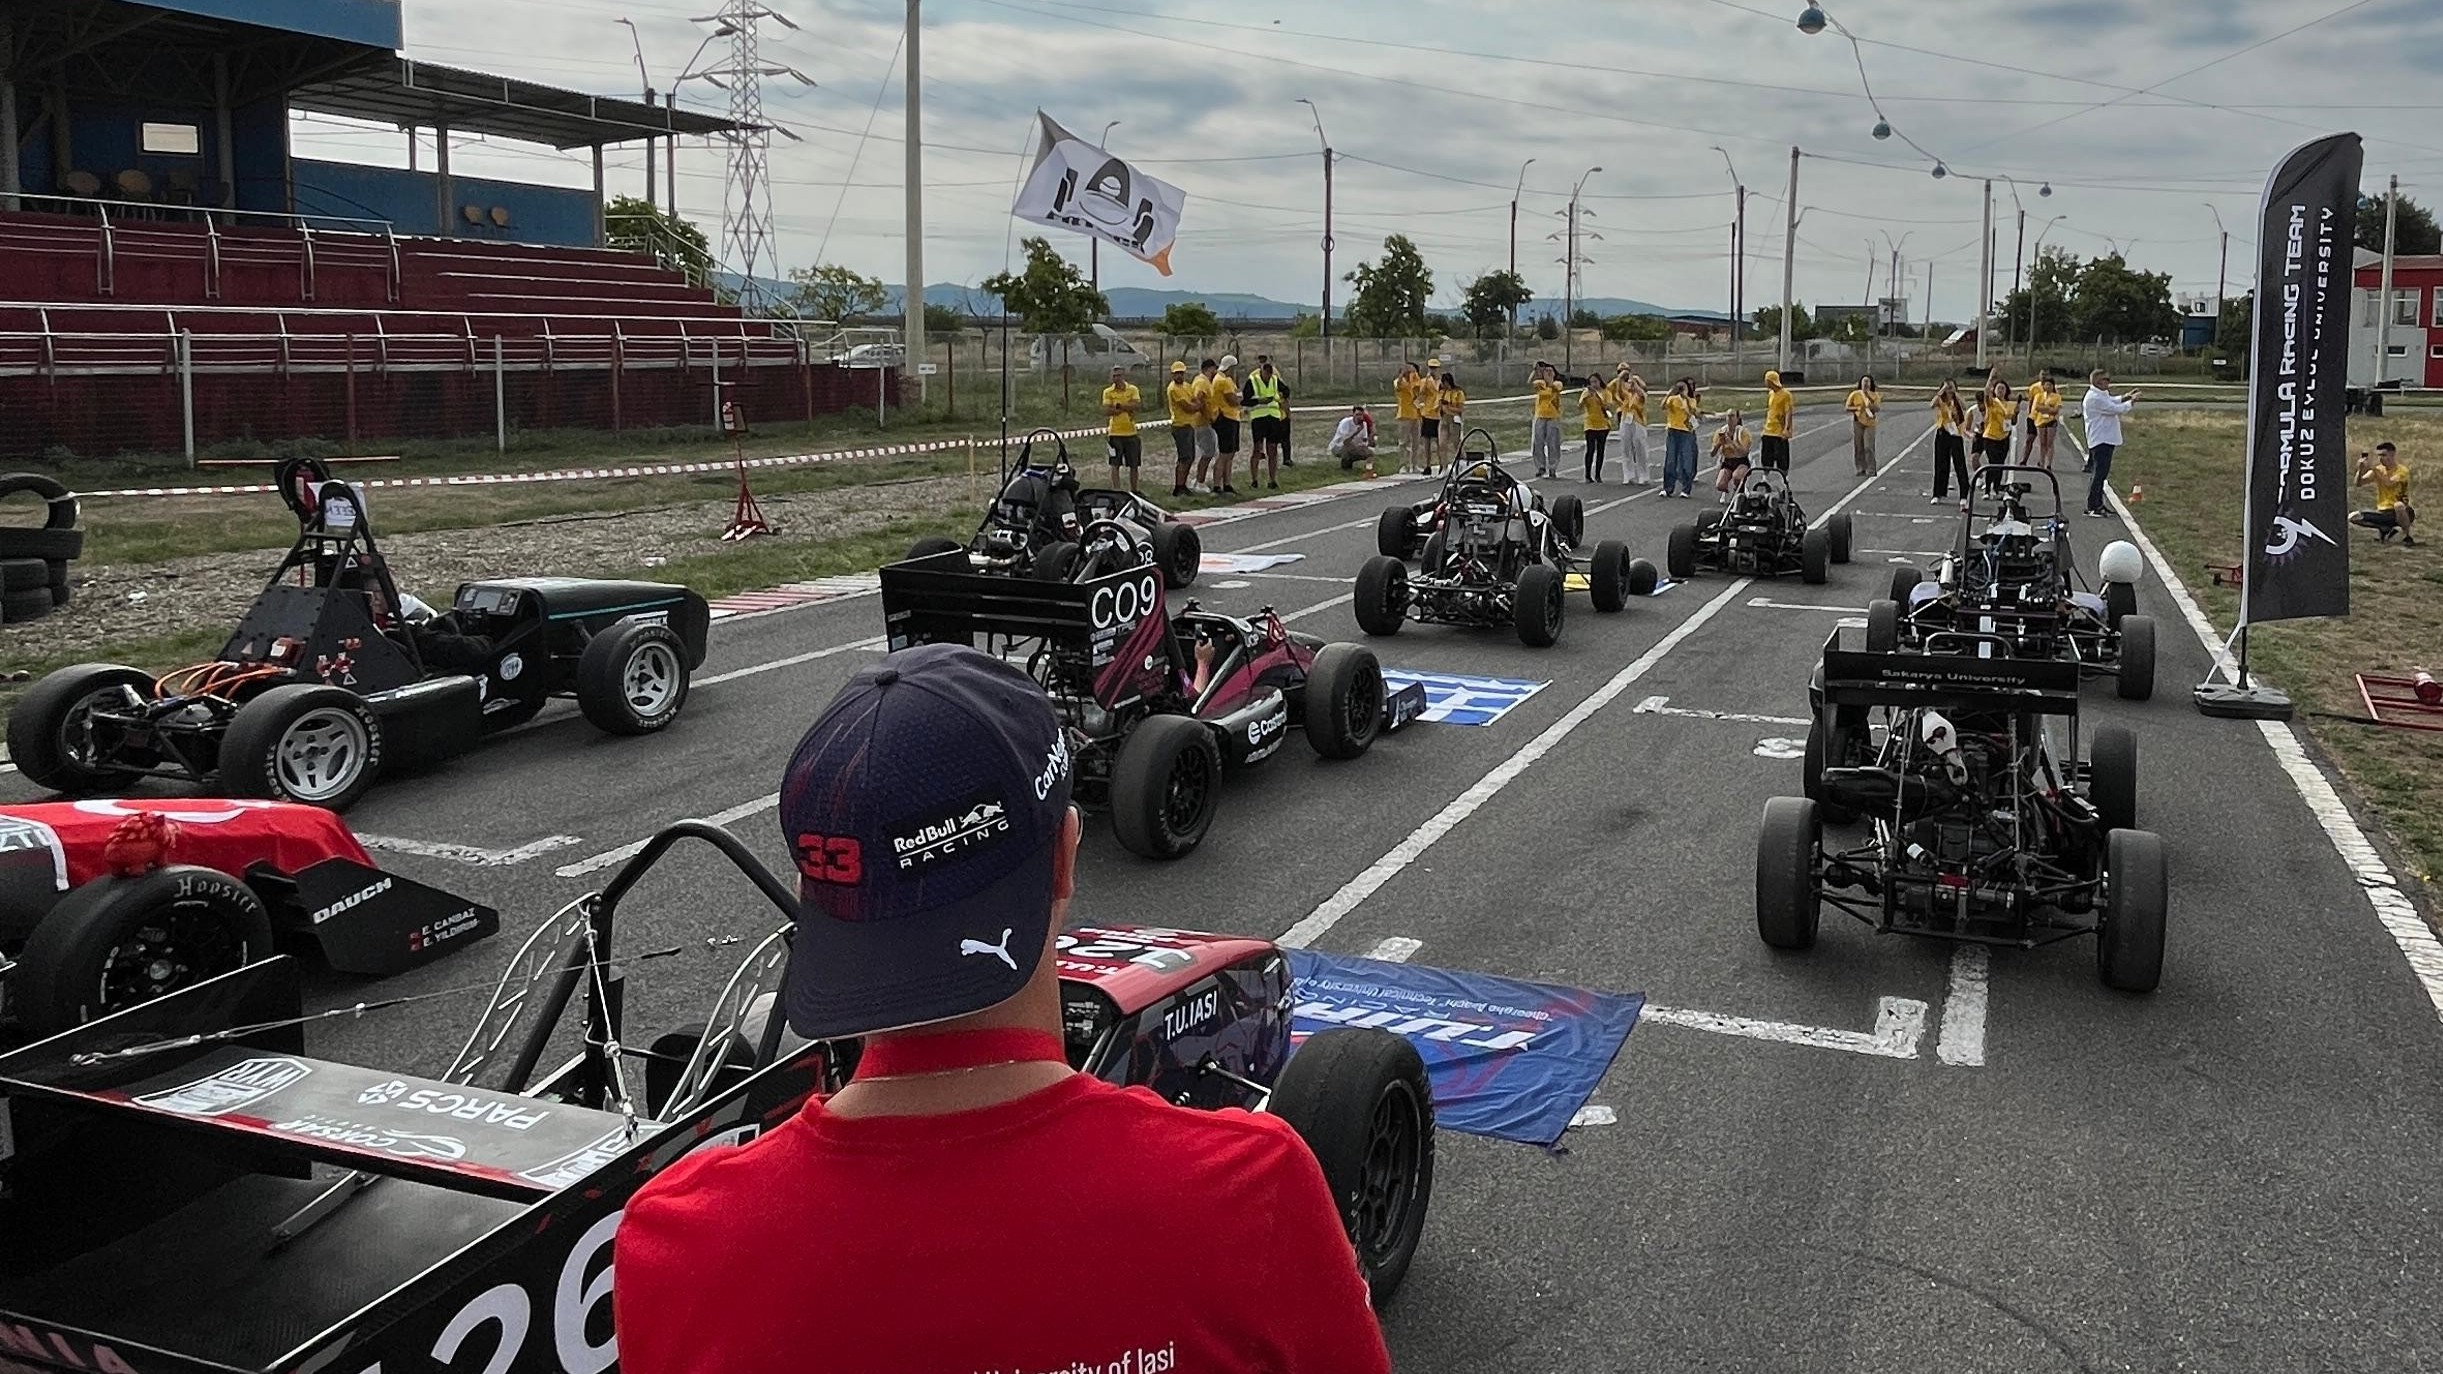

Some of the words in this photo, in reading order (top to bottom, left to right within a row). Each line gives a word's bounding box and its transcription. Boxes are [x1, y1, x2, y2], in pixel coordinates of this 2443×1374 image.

[2284, 205, 2306, 277] TEAM
[2279, 284, 2300, 375] RACING
[2300, 428, 2316, 500] DOKUZ
[1947, 672, 2026, 685] University
[798, 833, 861, 883] 33
[900, 819, 1009, 870] RACING
[174, 878, 258, 912] Hoosier
[312, 881, 393, 925] DAUCH
[1319, 979, 1384, 998] University
[1382, 989, 1436, 1006] Technical
[397, 1089, 550, 1131] PARCS
[356, 1208, 621, 1374] 26
[1138, 1341, 1175, 1374] Iasi
